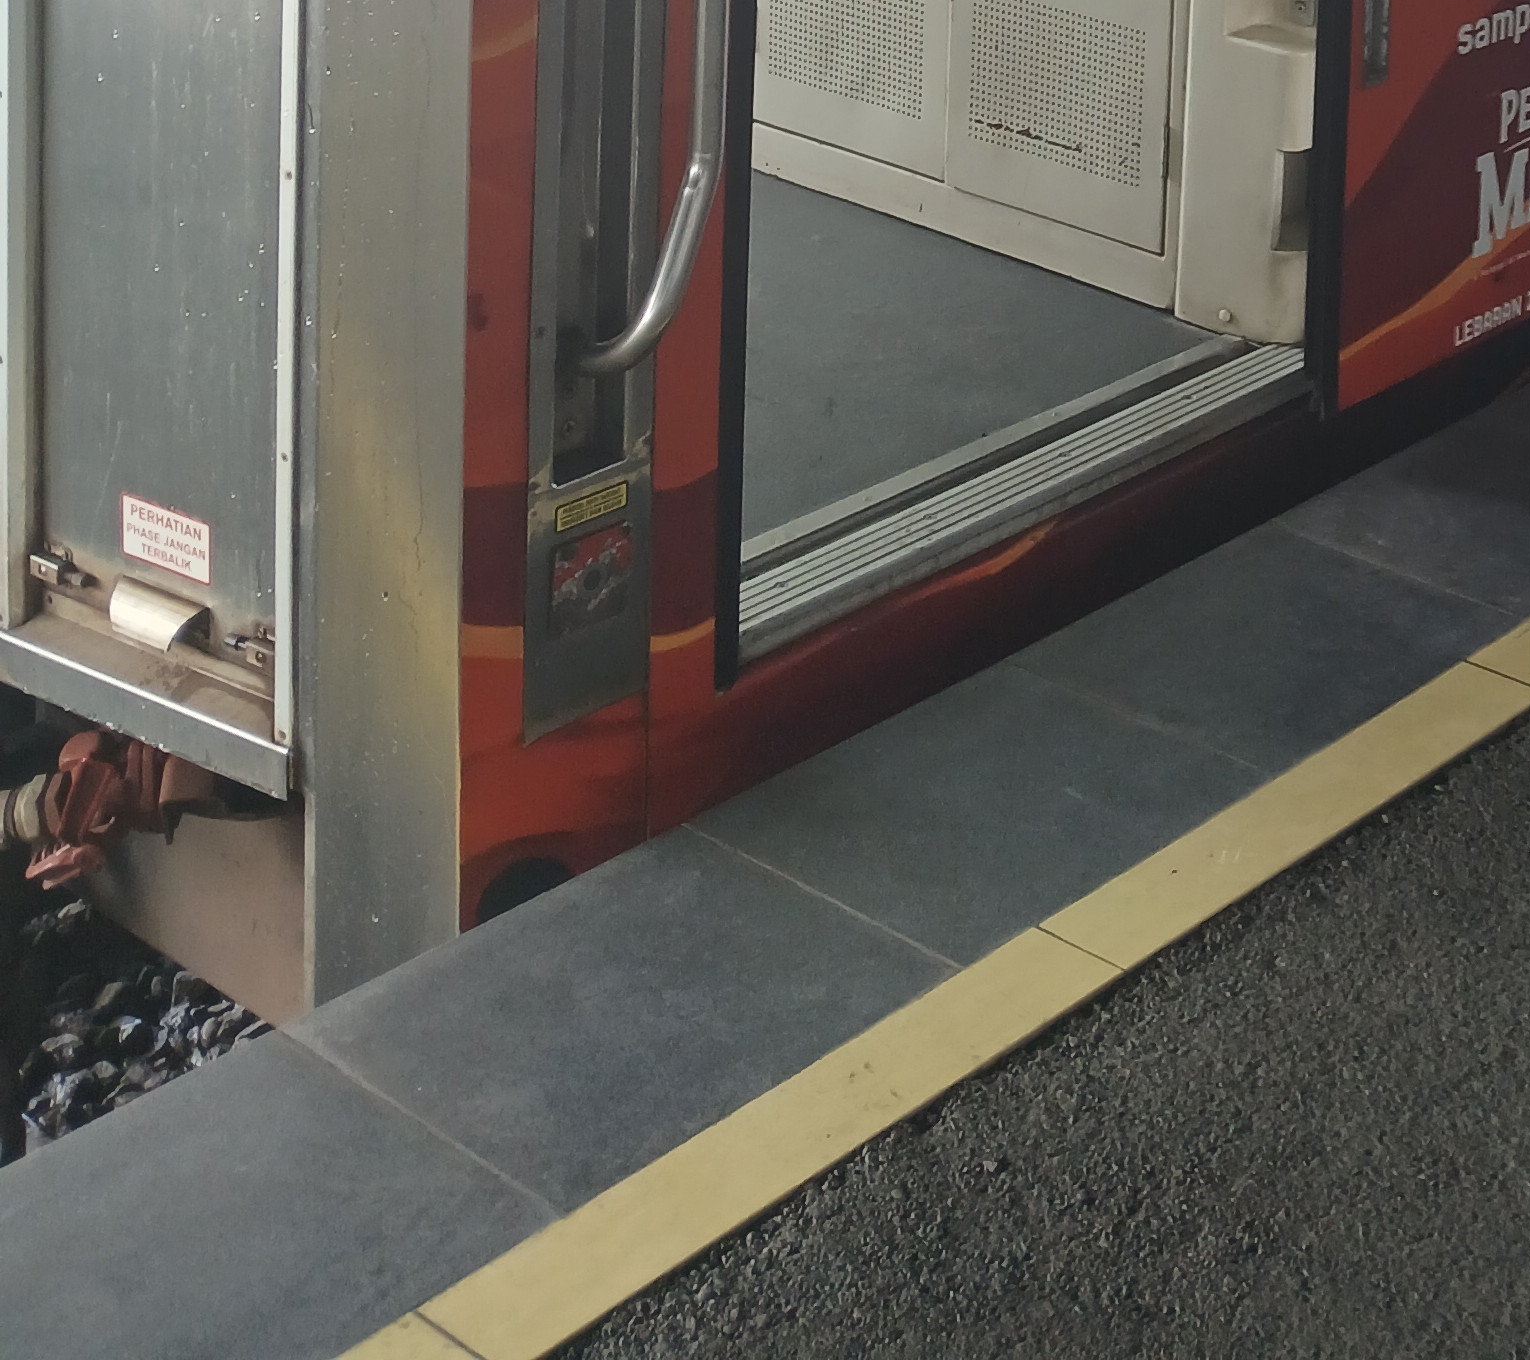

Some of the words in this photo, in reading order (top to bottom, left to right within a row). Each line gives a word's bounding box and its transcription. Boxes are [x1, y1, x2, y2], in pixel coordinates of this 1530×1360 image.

[1455, 295, 1523, 347] LEBARAN
[130, 503, 202, 542] PERHATIAN
[141, 543, 192, 572] TERBALIK
[163, 536, 206, 561] JANGAN
